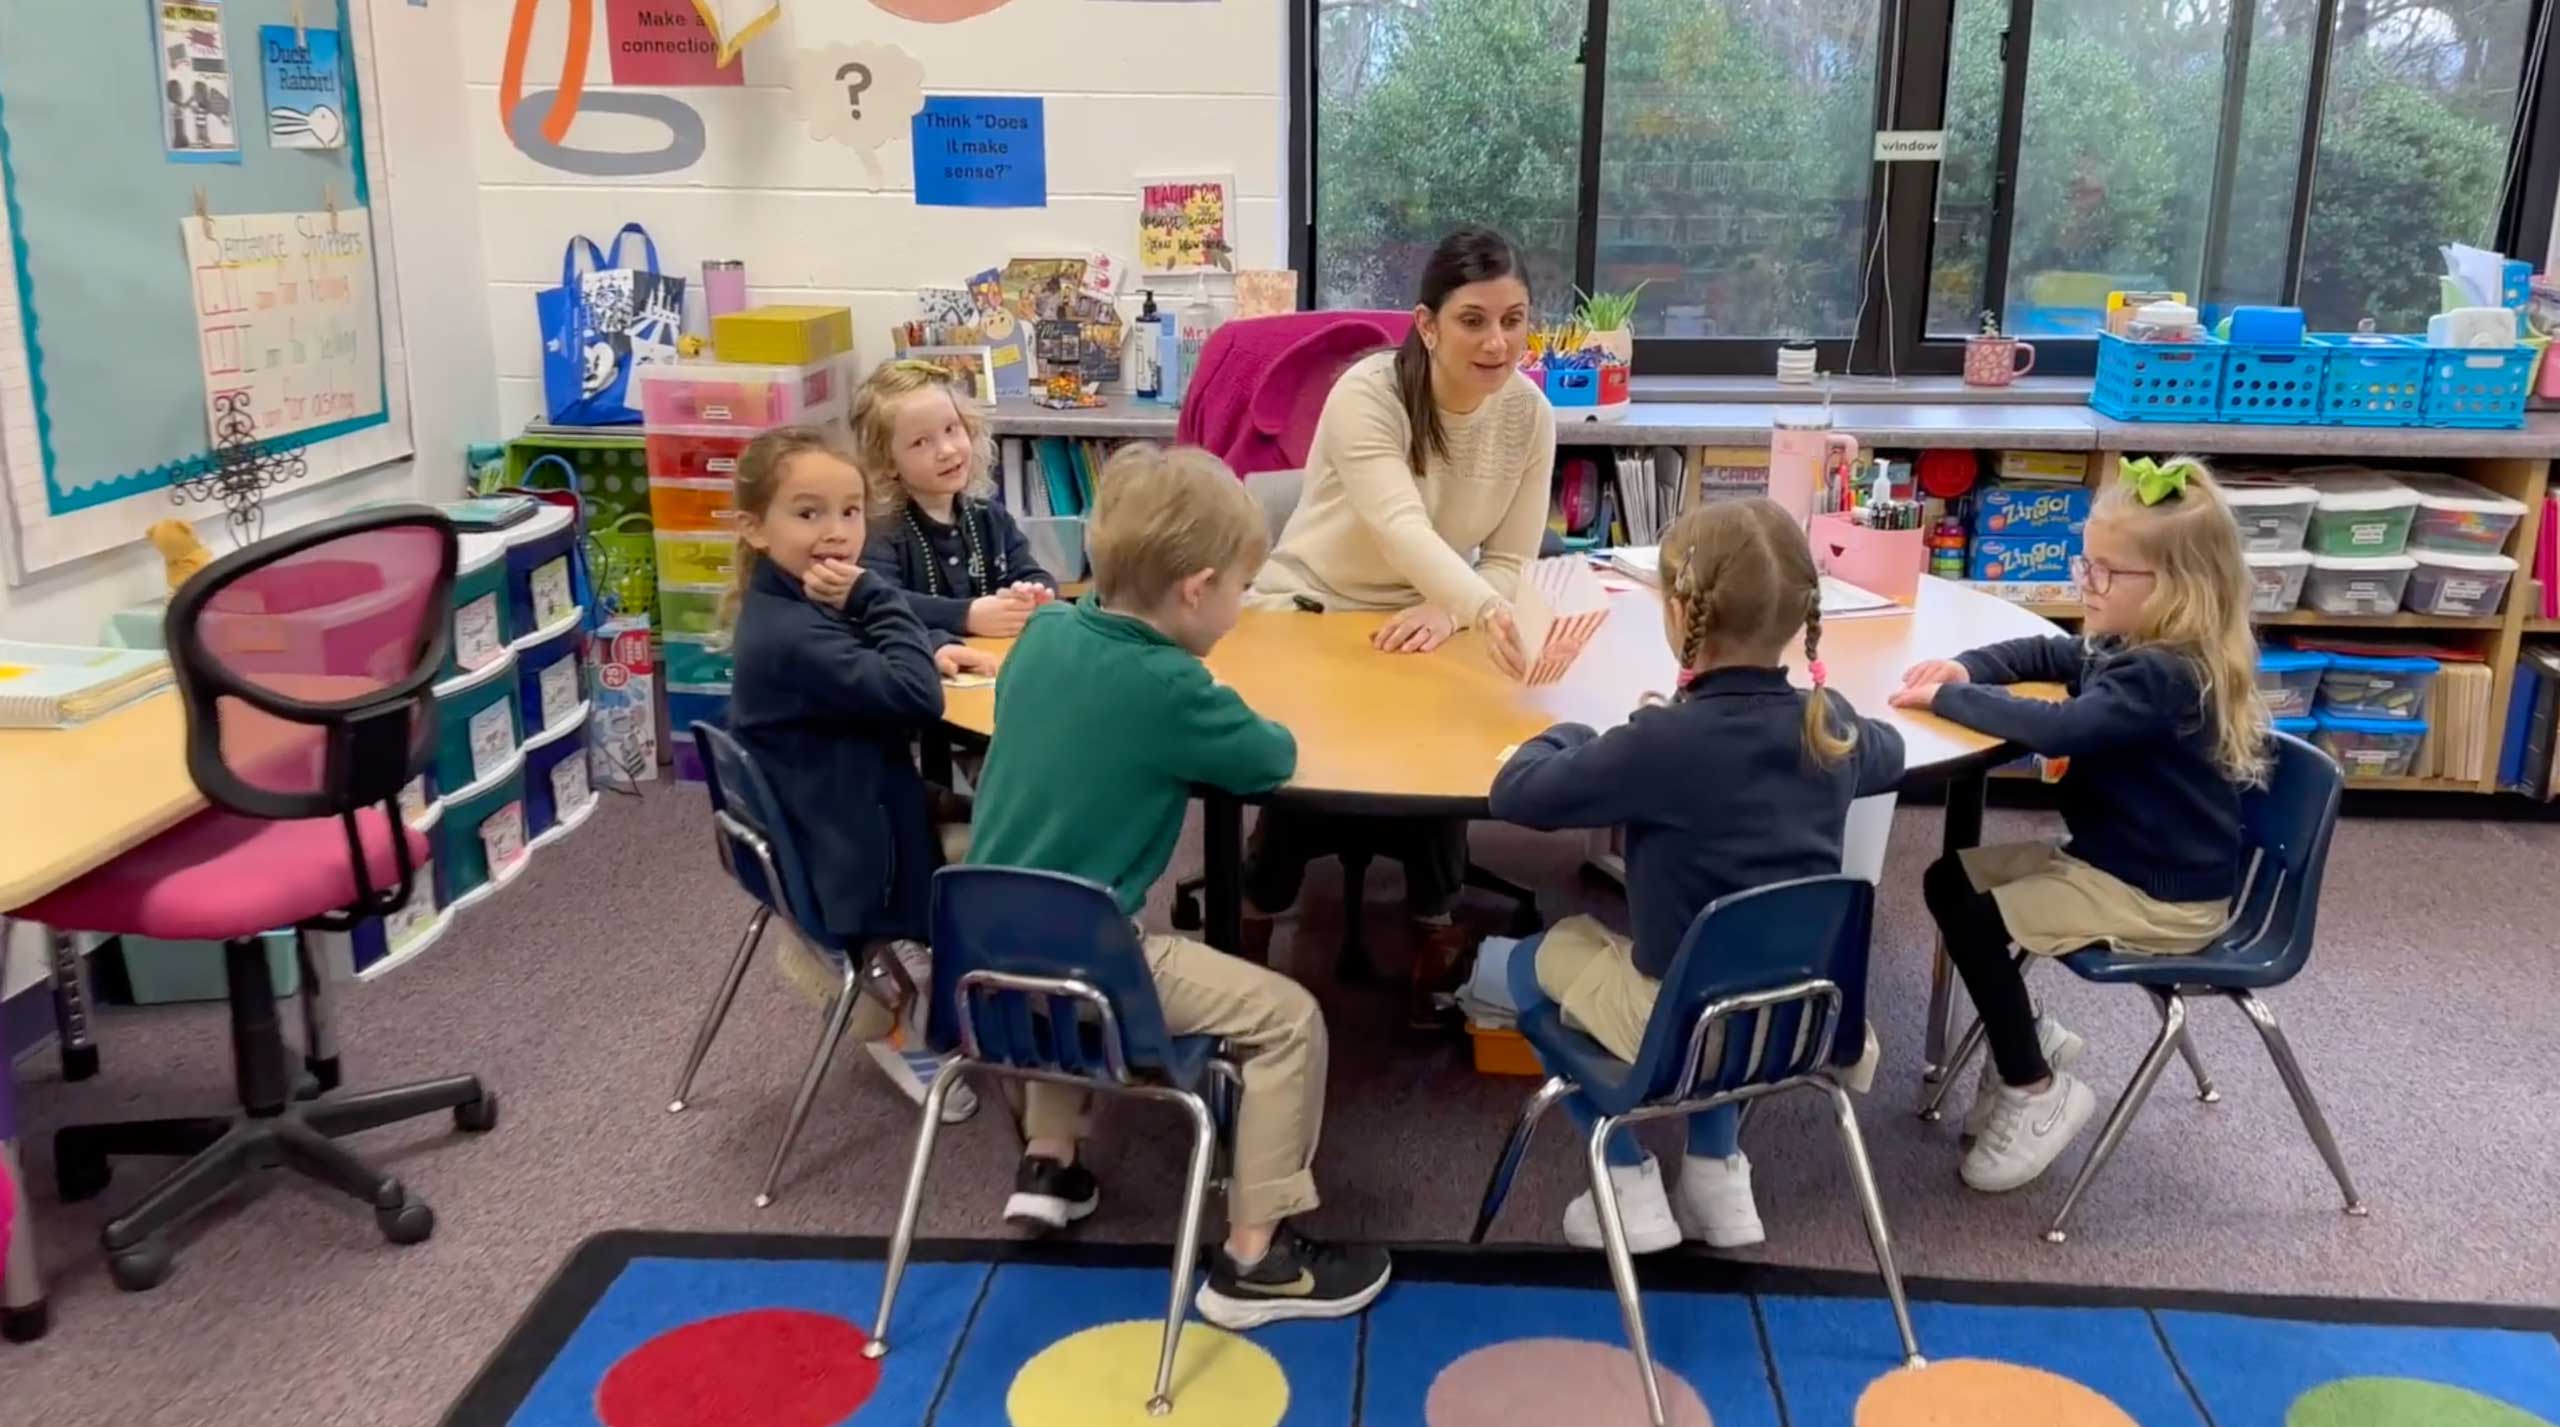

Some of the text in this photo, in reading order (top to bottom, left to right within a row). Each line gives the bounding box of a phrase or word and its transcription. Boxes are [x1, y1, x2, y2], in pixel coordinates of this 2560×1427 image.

[638, 11, 686, 26] Make
[925, 113, 971, 129] Think
[962, 139, 1009, 155] make
[1882, 141, 1939, 152] window
[2001, 493, 2072, 526] Zingo!
[1998, 539, 2068, 572] Zingo!
